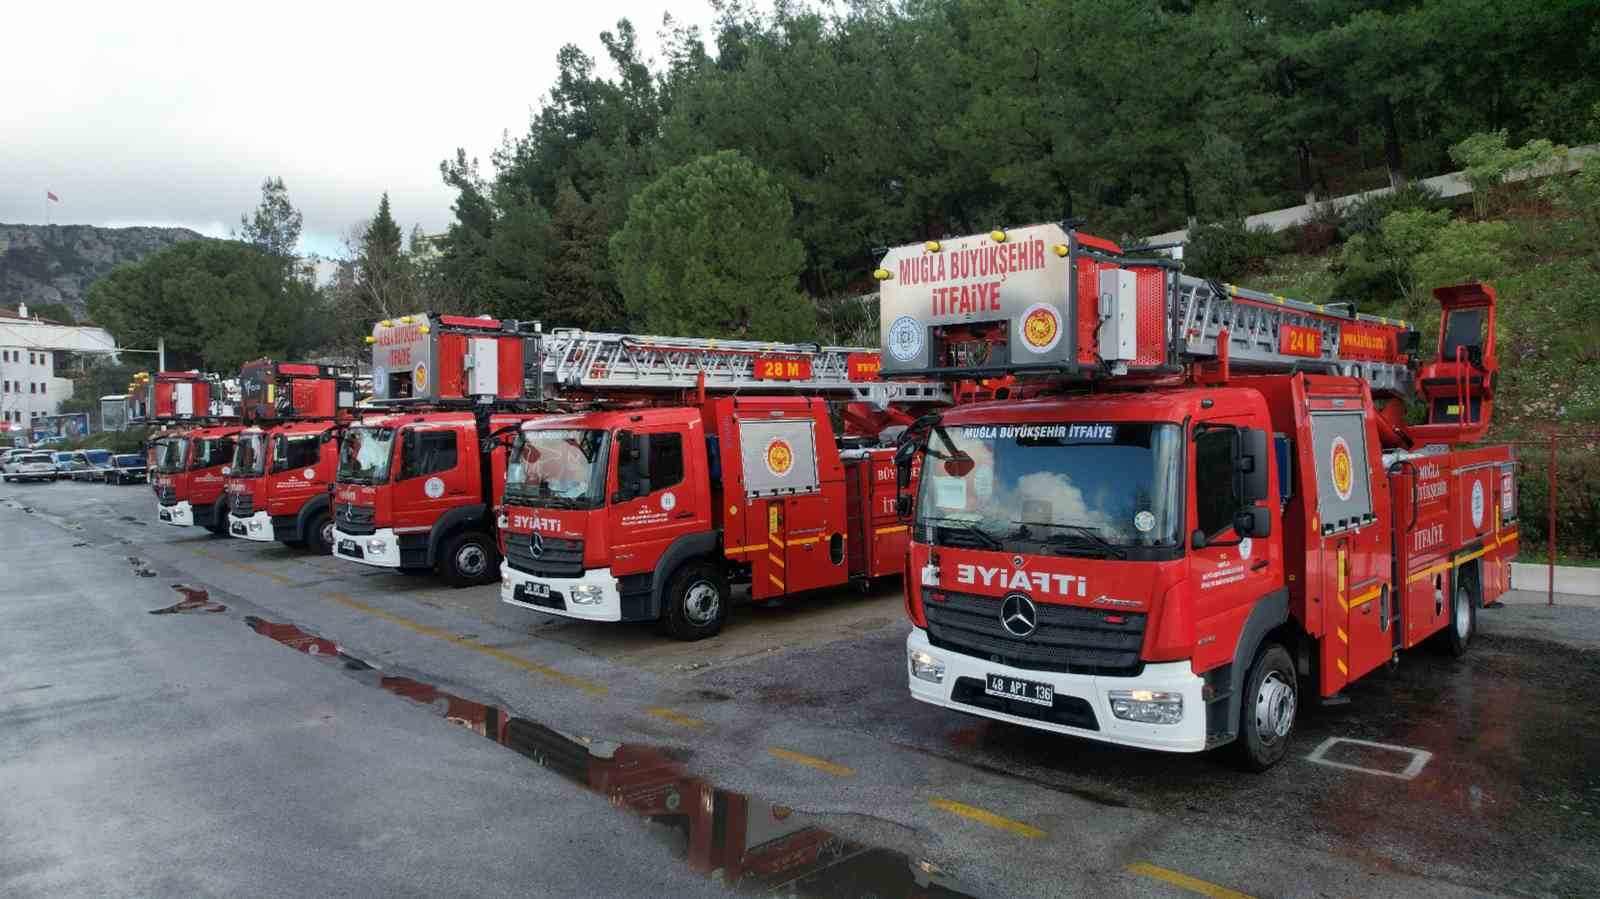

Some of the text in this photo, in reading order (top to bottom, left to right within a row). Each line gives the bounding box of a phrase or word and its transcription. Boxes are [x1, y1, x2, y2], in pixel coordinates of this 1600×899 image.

[899, 235, 1046, 286] MUĞLA BÜYÜKŞEHİR
[1290, 330, 1315, 353] 24 M
[765, 362, 799, 377] 28 M
[963, 423, 1113, 440] MUĞLA BÜYÜKŞEHİR İTFAİYE
[991, 676, 1051, 700] 48 APT 136
